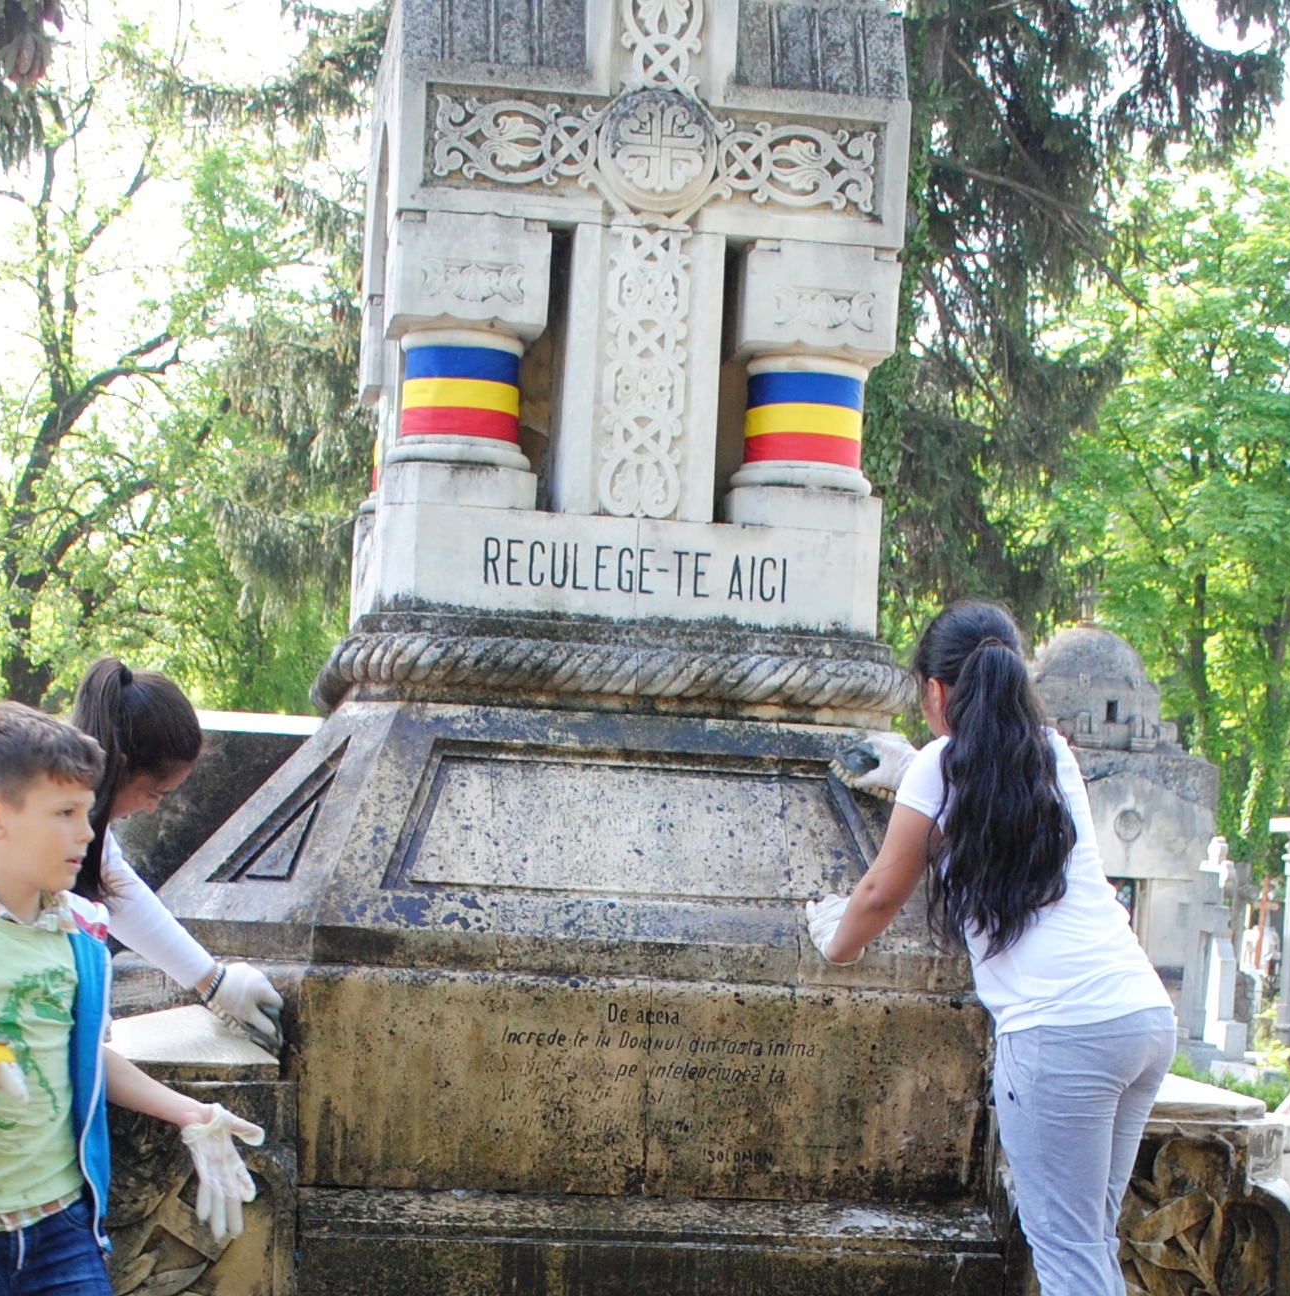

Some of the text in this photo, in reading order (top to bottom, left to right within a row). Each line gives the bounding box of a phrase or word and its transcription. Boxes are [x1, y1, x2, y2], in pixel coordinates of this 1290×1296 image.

[483, 536, 788, 604] RECULEGE-TE AICI
[608, 1002, 628, 1024] De
[689, 1035, 716, 1055] din
[614, 1062, 639, 1082] pe
